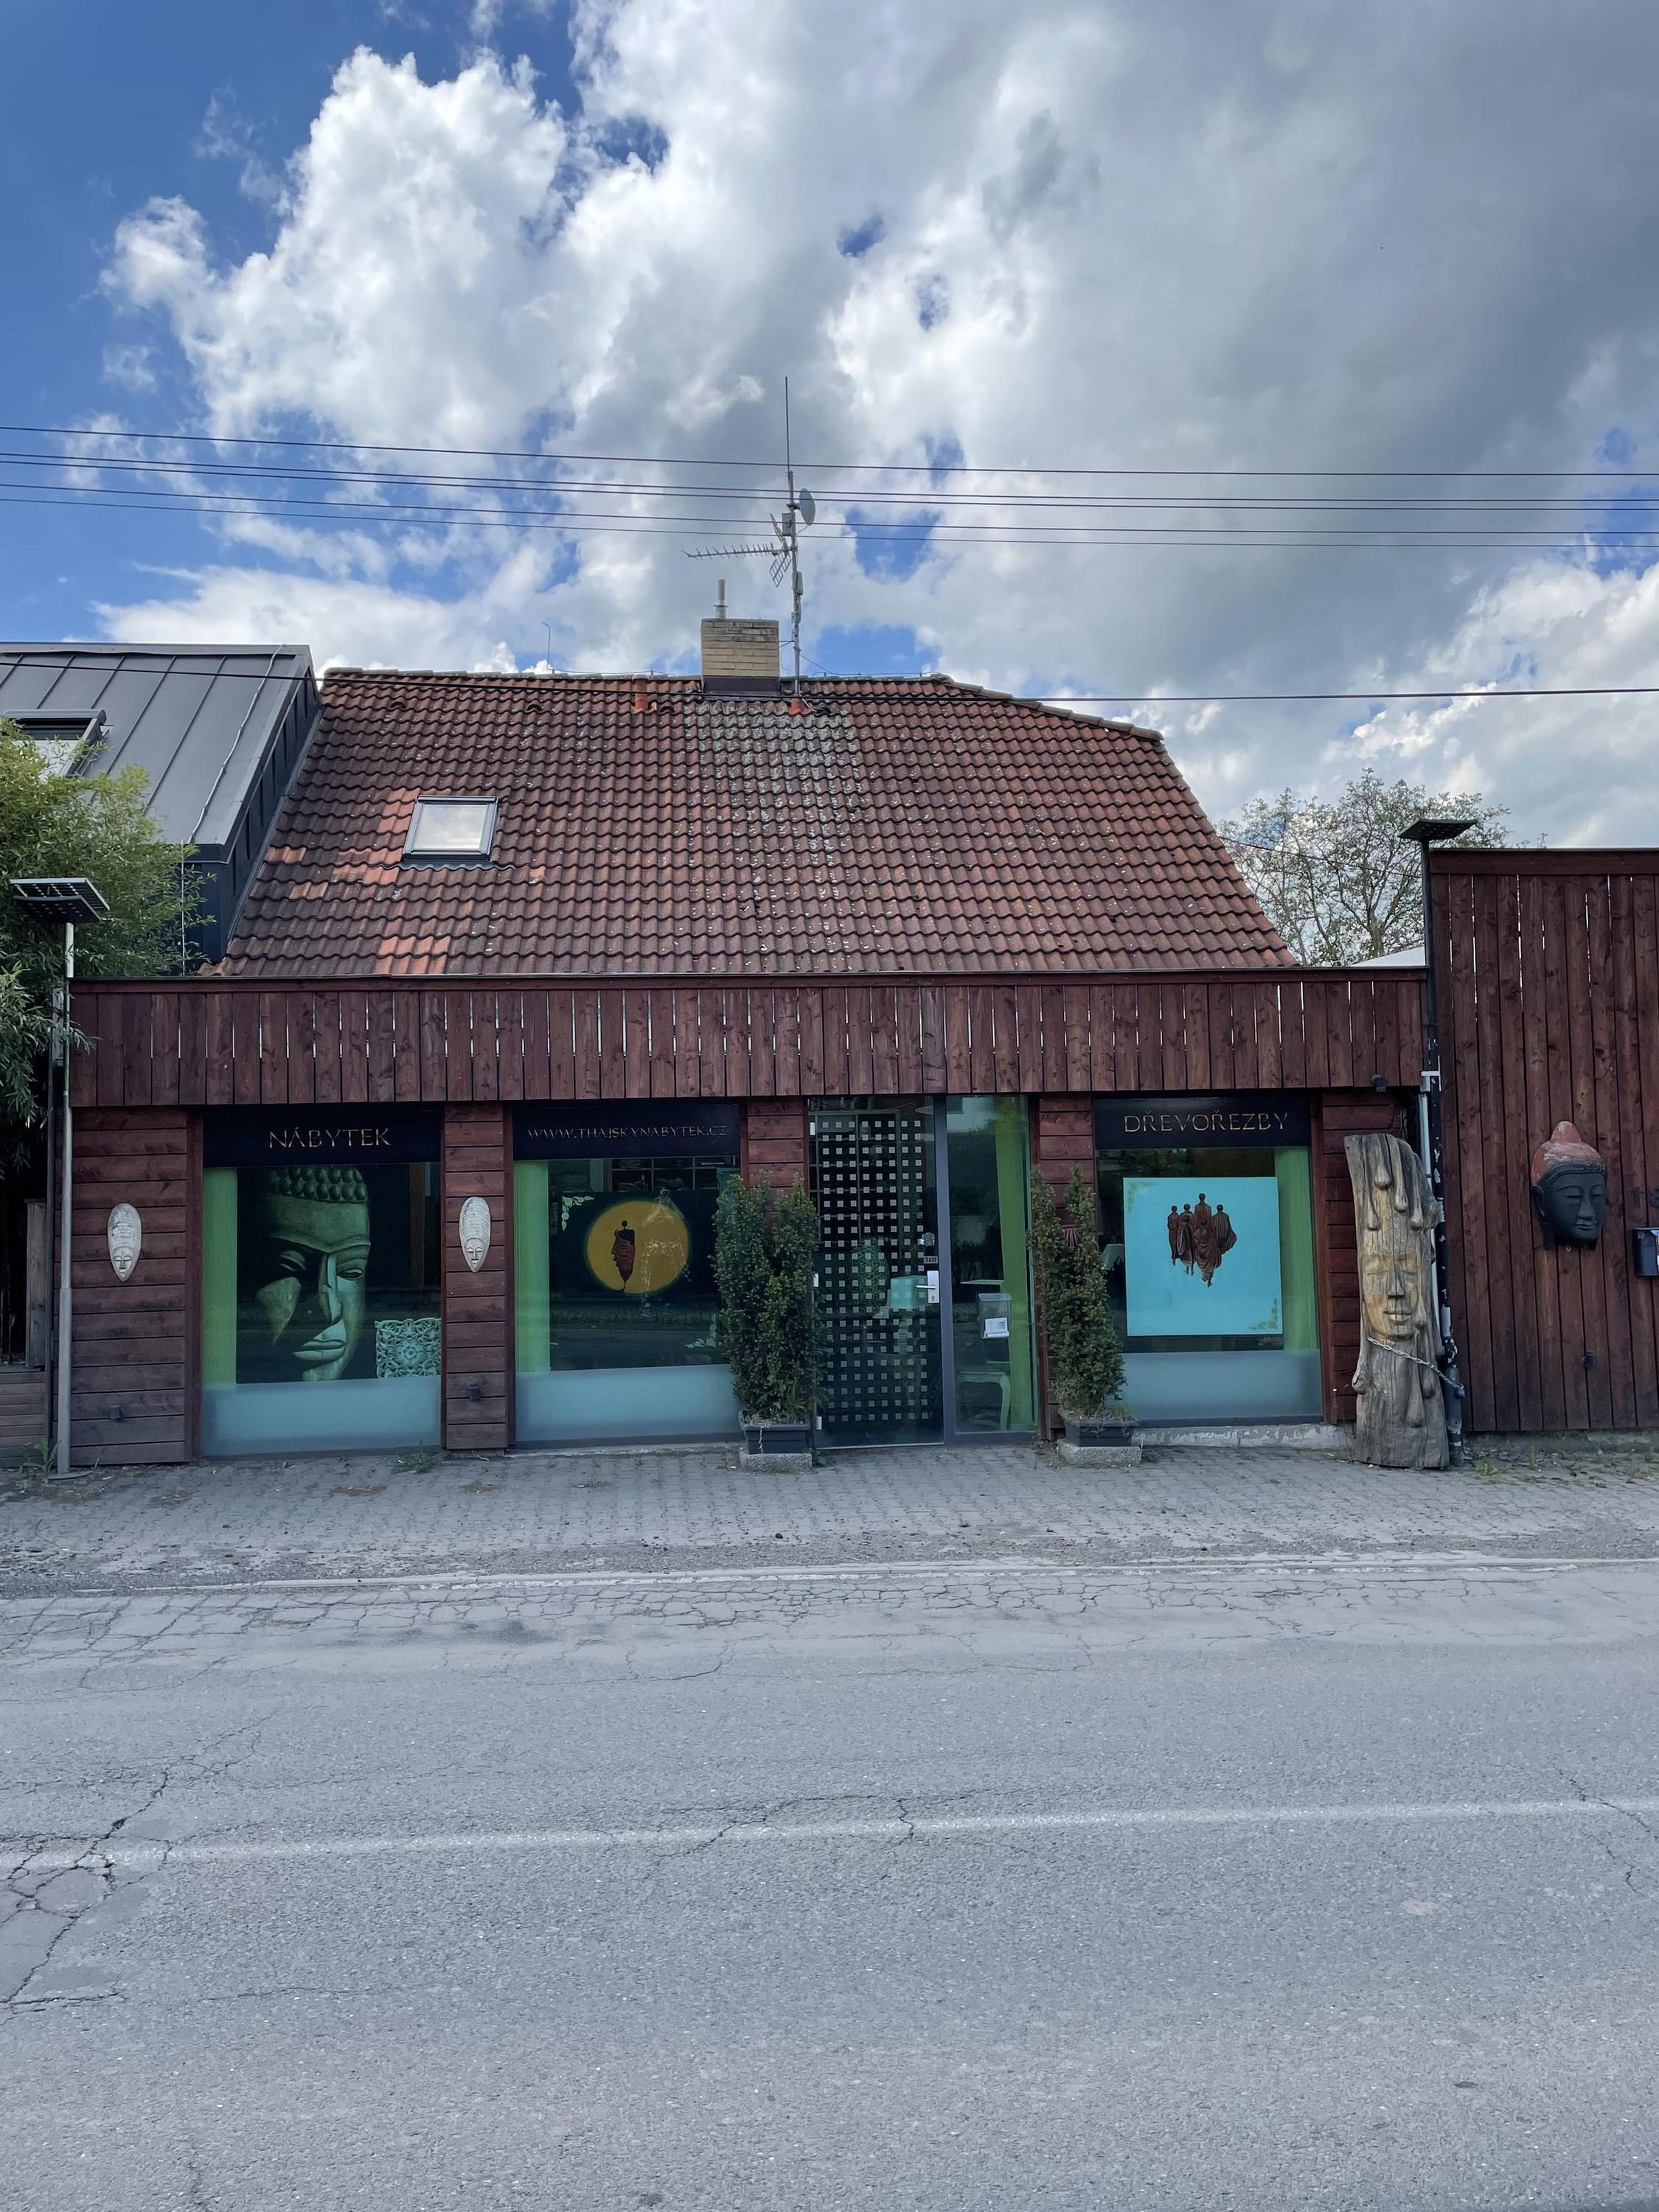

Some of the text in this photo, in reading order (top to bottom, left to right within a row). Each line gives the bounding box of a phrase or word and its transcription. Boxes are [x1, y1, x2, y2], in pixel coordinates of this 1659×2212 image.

[527, 1125, 726, 1139] WWW.THAJSKYNABYTEK.CZ
[1124, 1110, 1287, 1133] DŘEVOŘEZBY
[268, 1127, 392, 1148] NÁBYTEK
